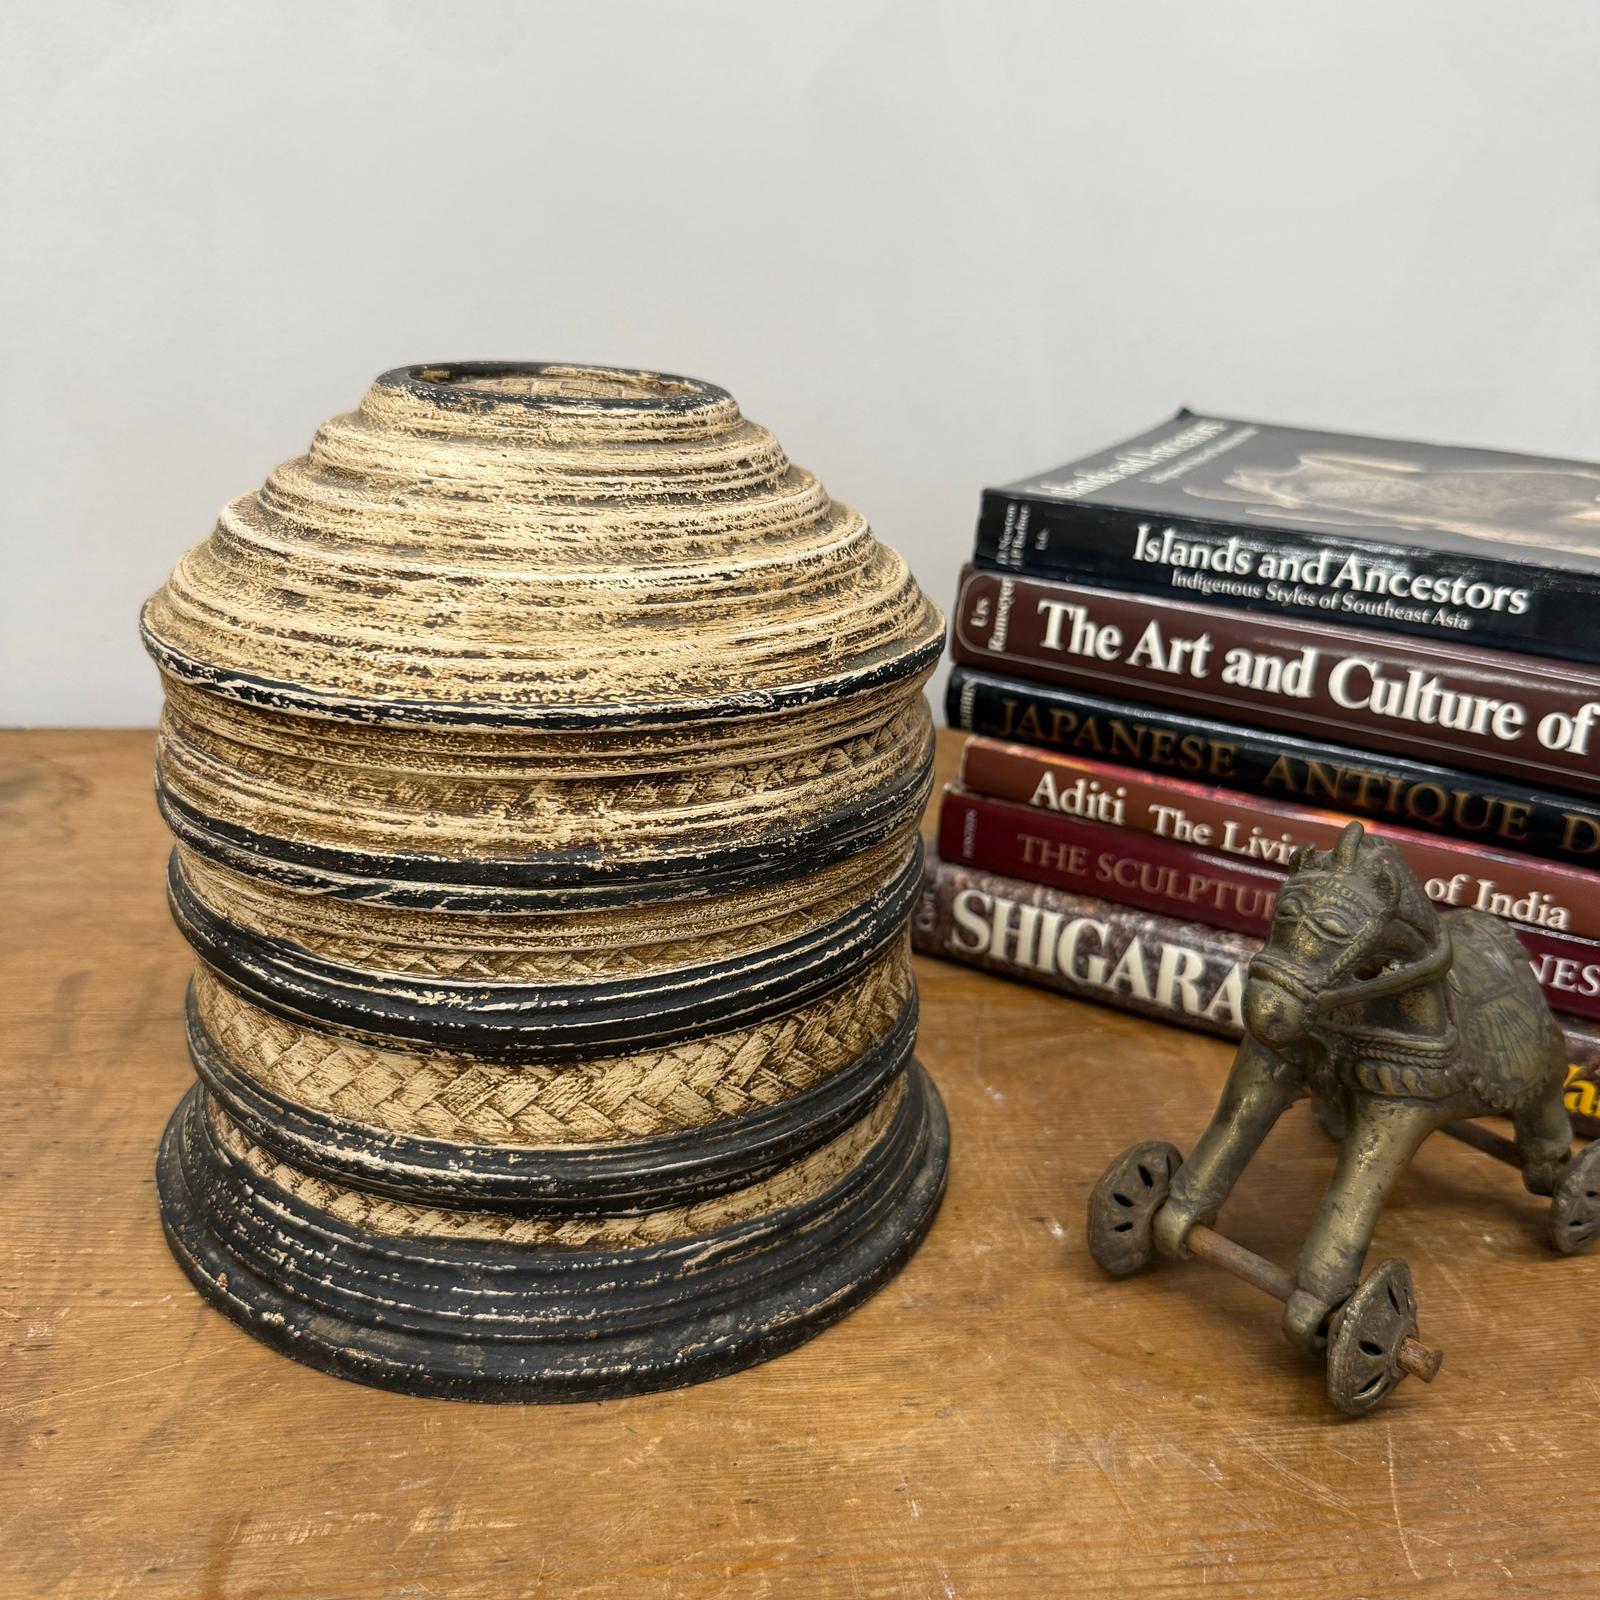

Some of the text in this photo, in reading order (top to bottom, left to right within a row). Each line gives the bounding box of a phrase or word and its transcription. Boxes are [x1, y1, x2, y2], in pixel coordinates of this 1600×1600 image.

[970, 595, 990, 627] Urs
[988, 576, 1016, 652] Ramseyer
[1132, 523, 1531, 614] Islands and Ancestors
[1171, 568, 1471, 631] Indigenous Styles of Southeast Asia
[1037, 599, 1600, 755] The Art and Culture of
[1001, 700, 1238, 778] JAPANESE
[1263, 754, 1534, 839] ANTIQUE
[1017, 834, 1089, 876] THE
[1029, 771, 1128, 825] Aditi
[1149, 805, 1213, 845] The
[1424, 873, 1471, 904] of
[1472, 878, 1571, 931] India
[952, 889, 1245, 1029] SHIGARA
